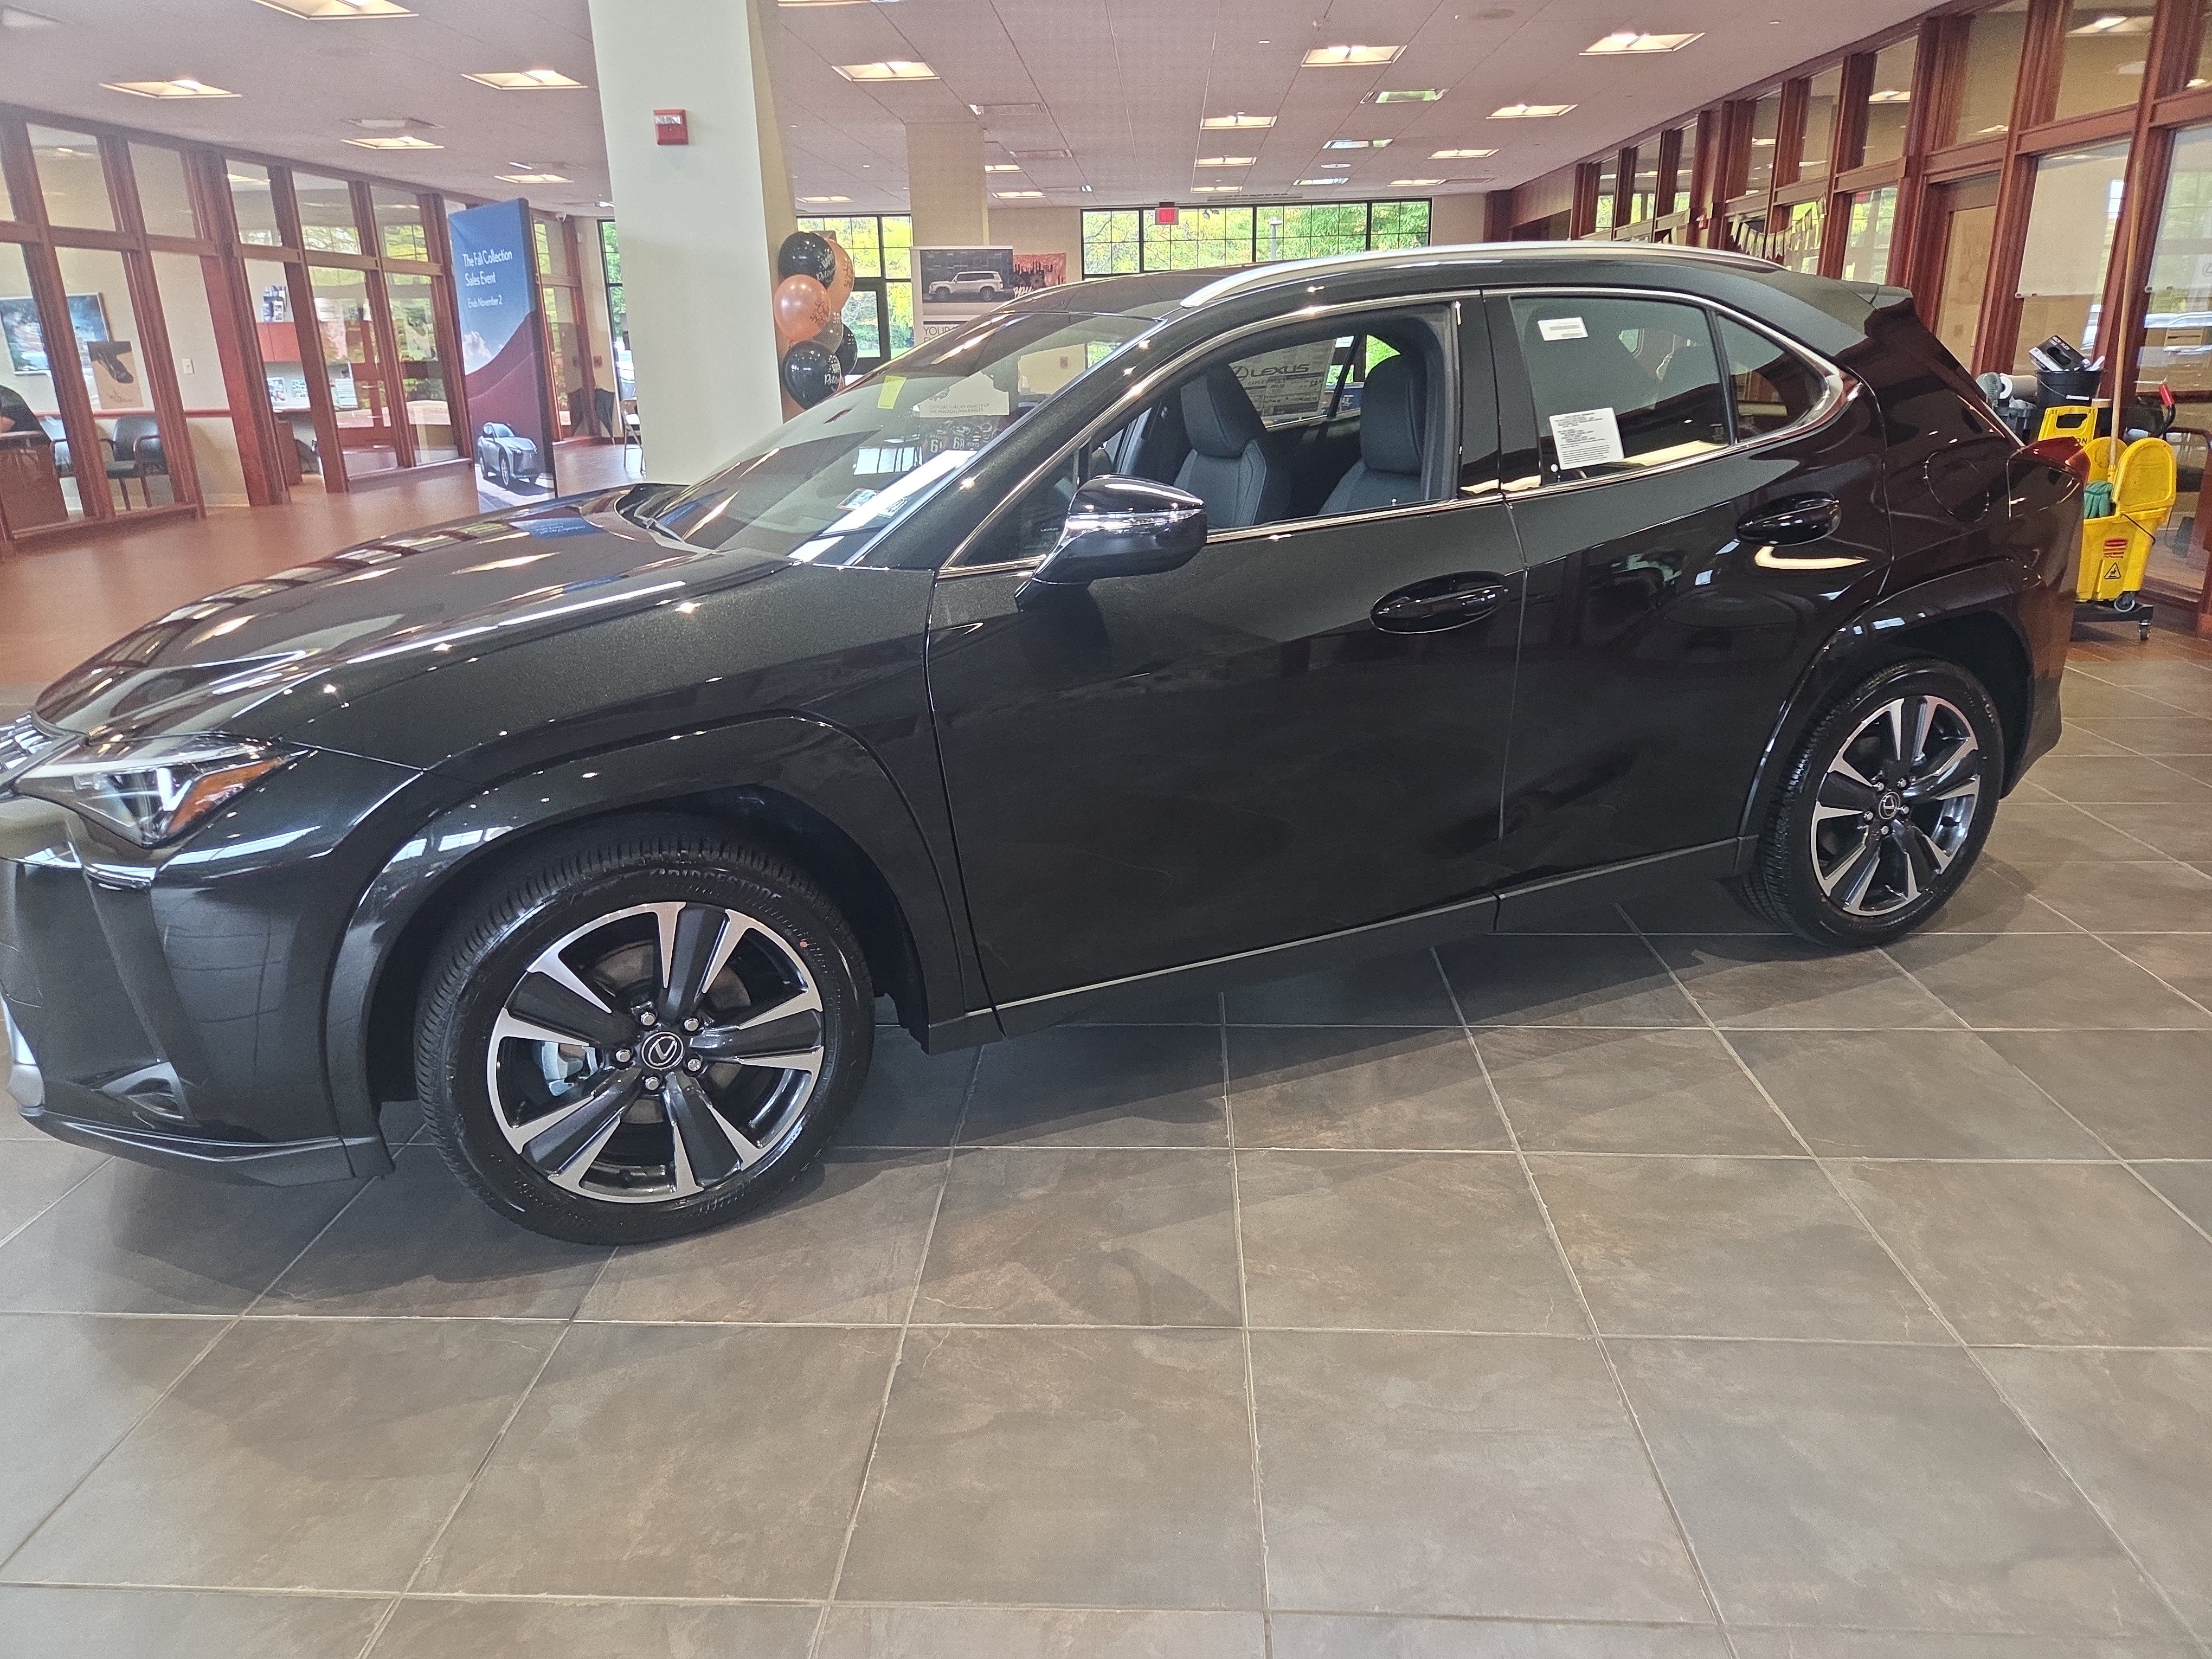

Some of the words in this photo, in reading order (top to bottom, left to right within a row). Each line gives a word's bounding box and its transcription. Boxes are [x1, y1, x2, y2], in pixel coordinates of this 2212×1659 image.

[462, 253, 474, 267] The
[473, 252, 484, 266] Fall
[483, 249, 512, 264] Collection
[465, 272, 480, 286] Sales
[479, 271, 496, 285] Event
[467, 298, 478, 308] Ends
[477, 295, 498, 307] November
[498, 294, 503, 305] 2
[1251, 364, 1310, 377] LEXUS
